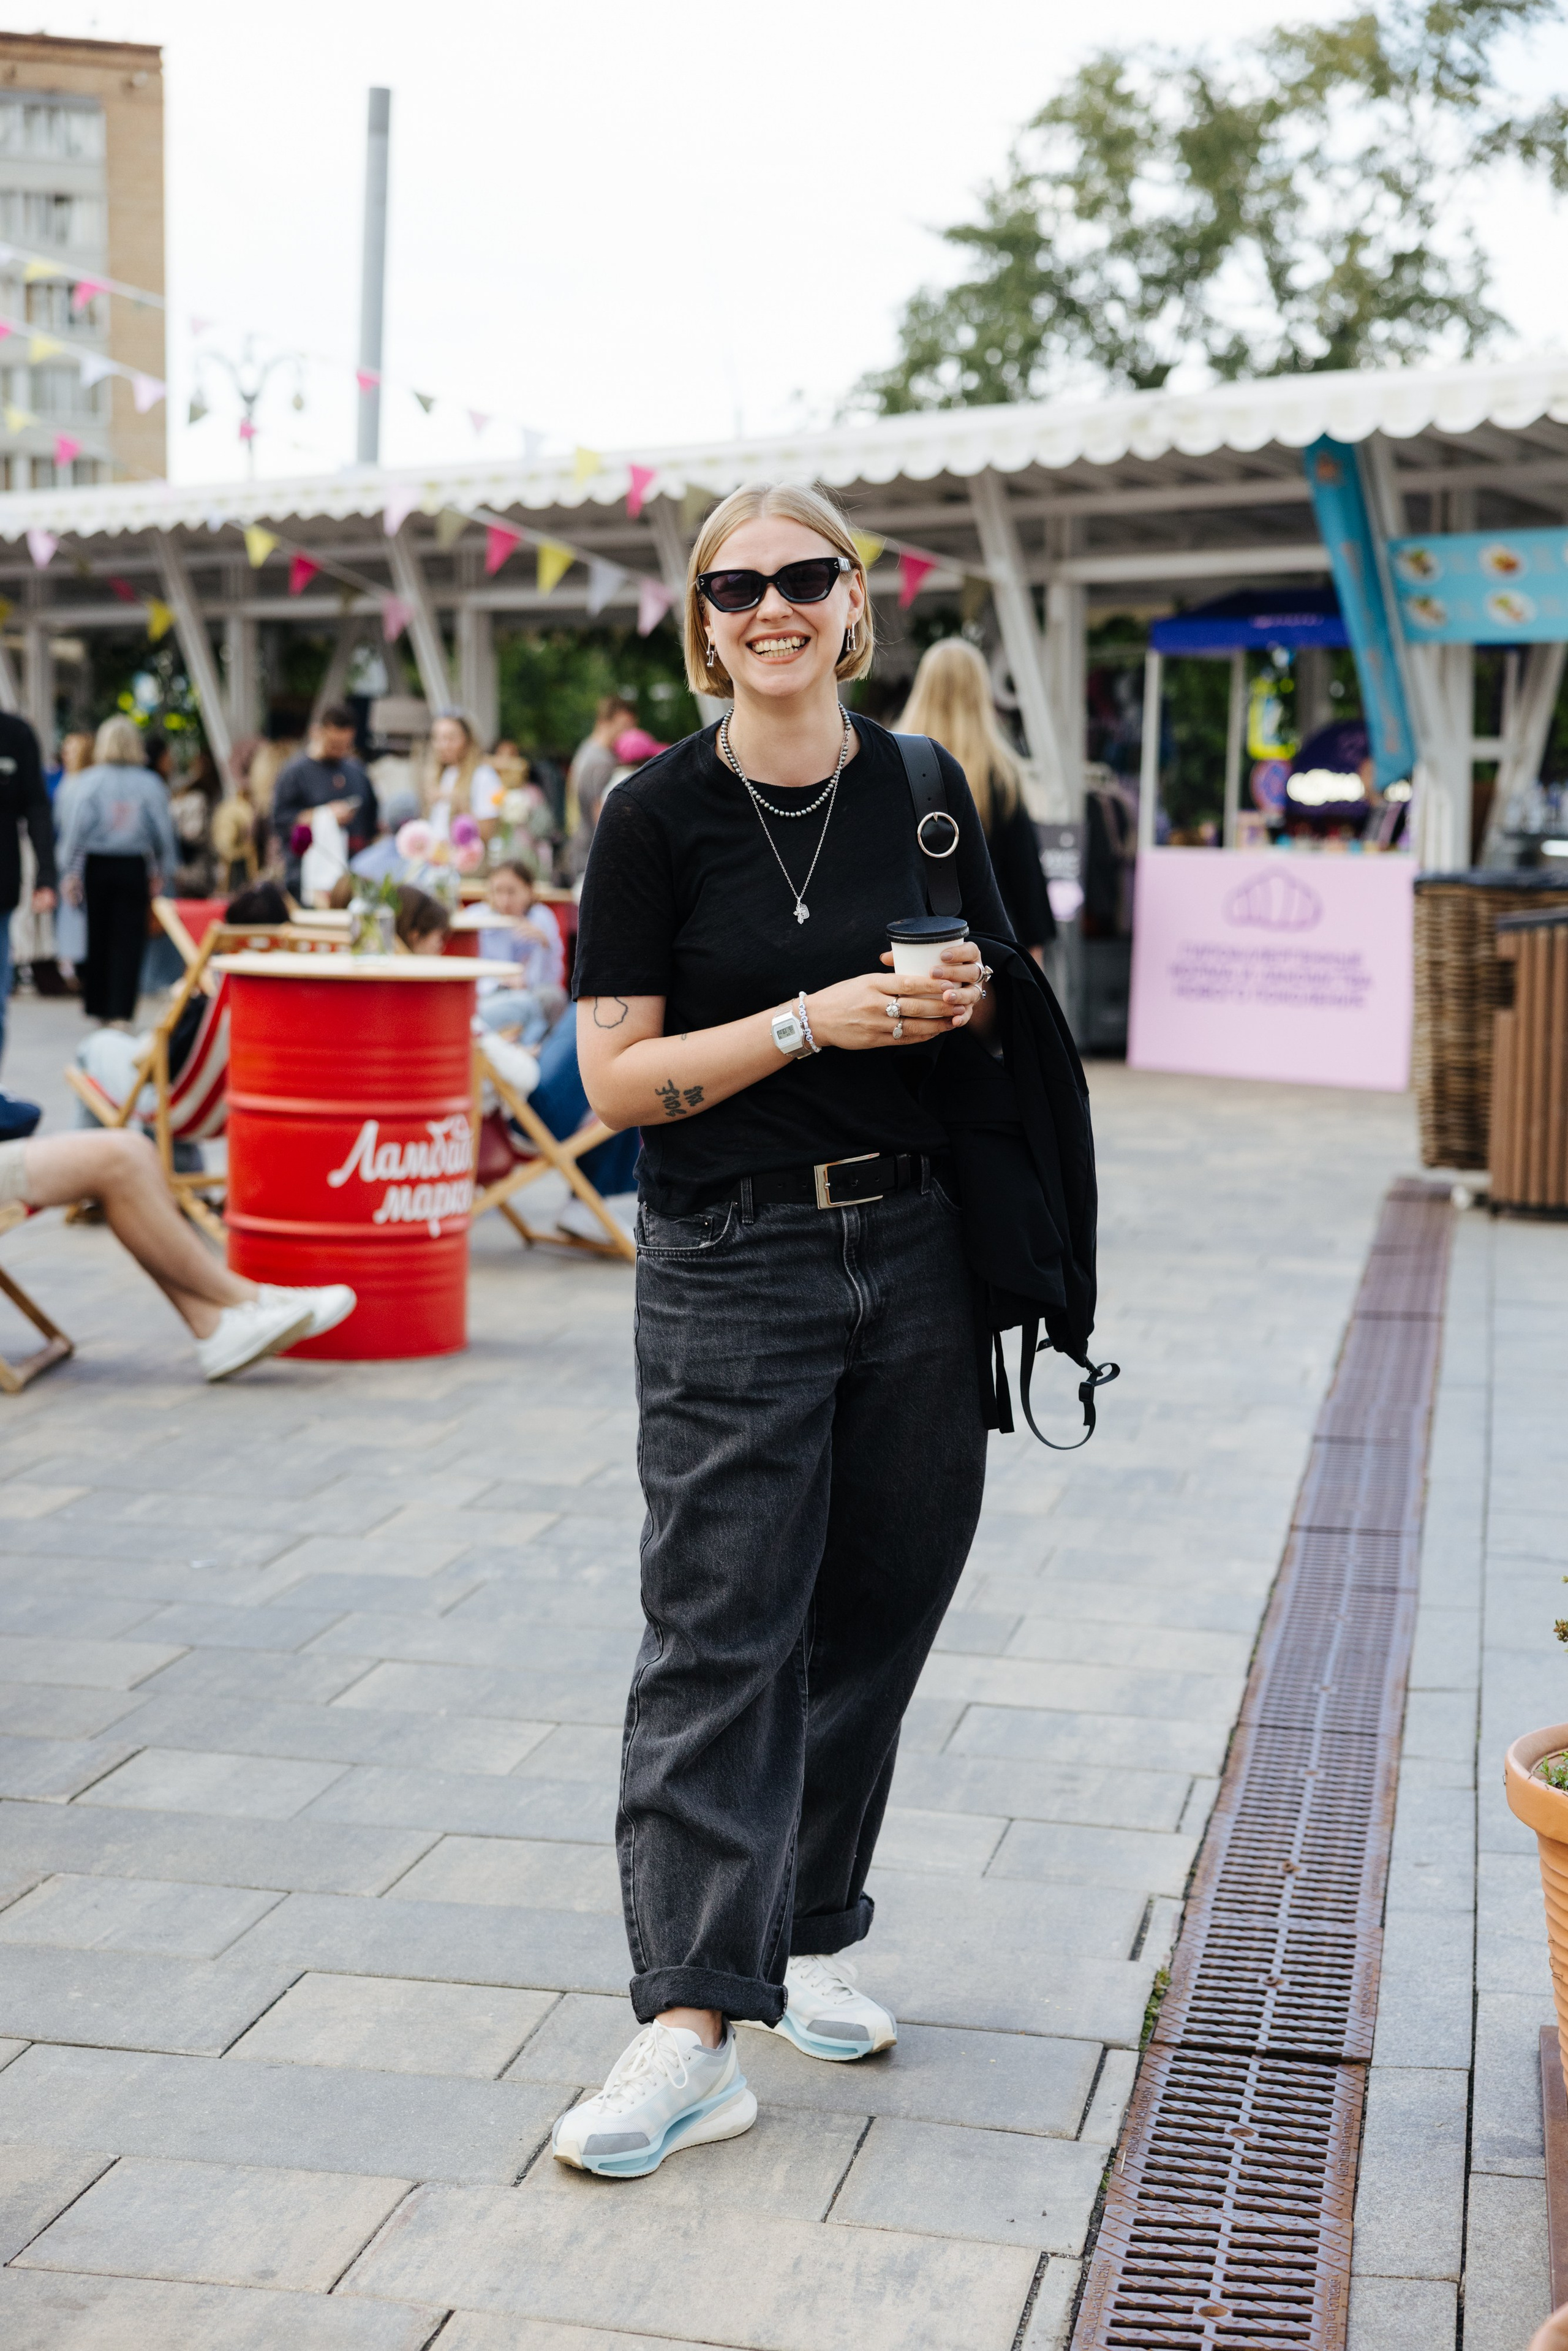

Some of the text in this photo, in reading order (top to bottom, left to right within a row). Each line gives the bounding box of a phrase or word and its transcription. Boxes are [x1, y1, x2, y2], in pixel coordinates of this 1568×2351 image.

[1341, 2111, 1354, 2137] GIDROLICA
[1326, 2278, 1341, 2311] GIDROLICA
[1081, 2309, 1100, 2344] GIDROLICA
